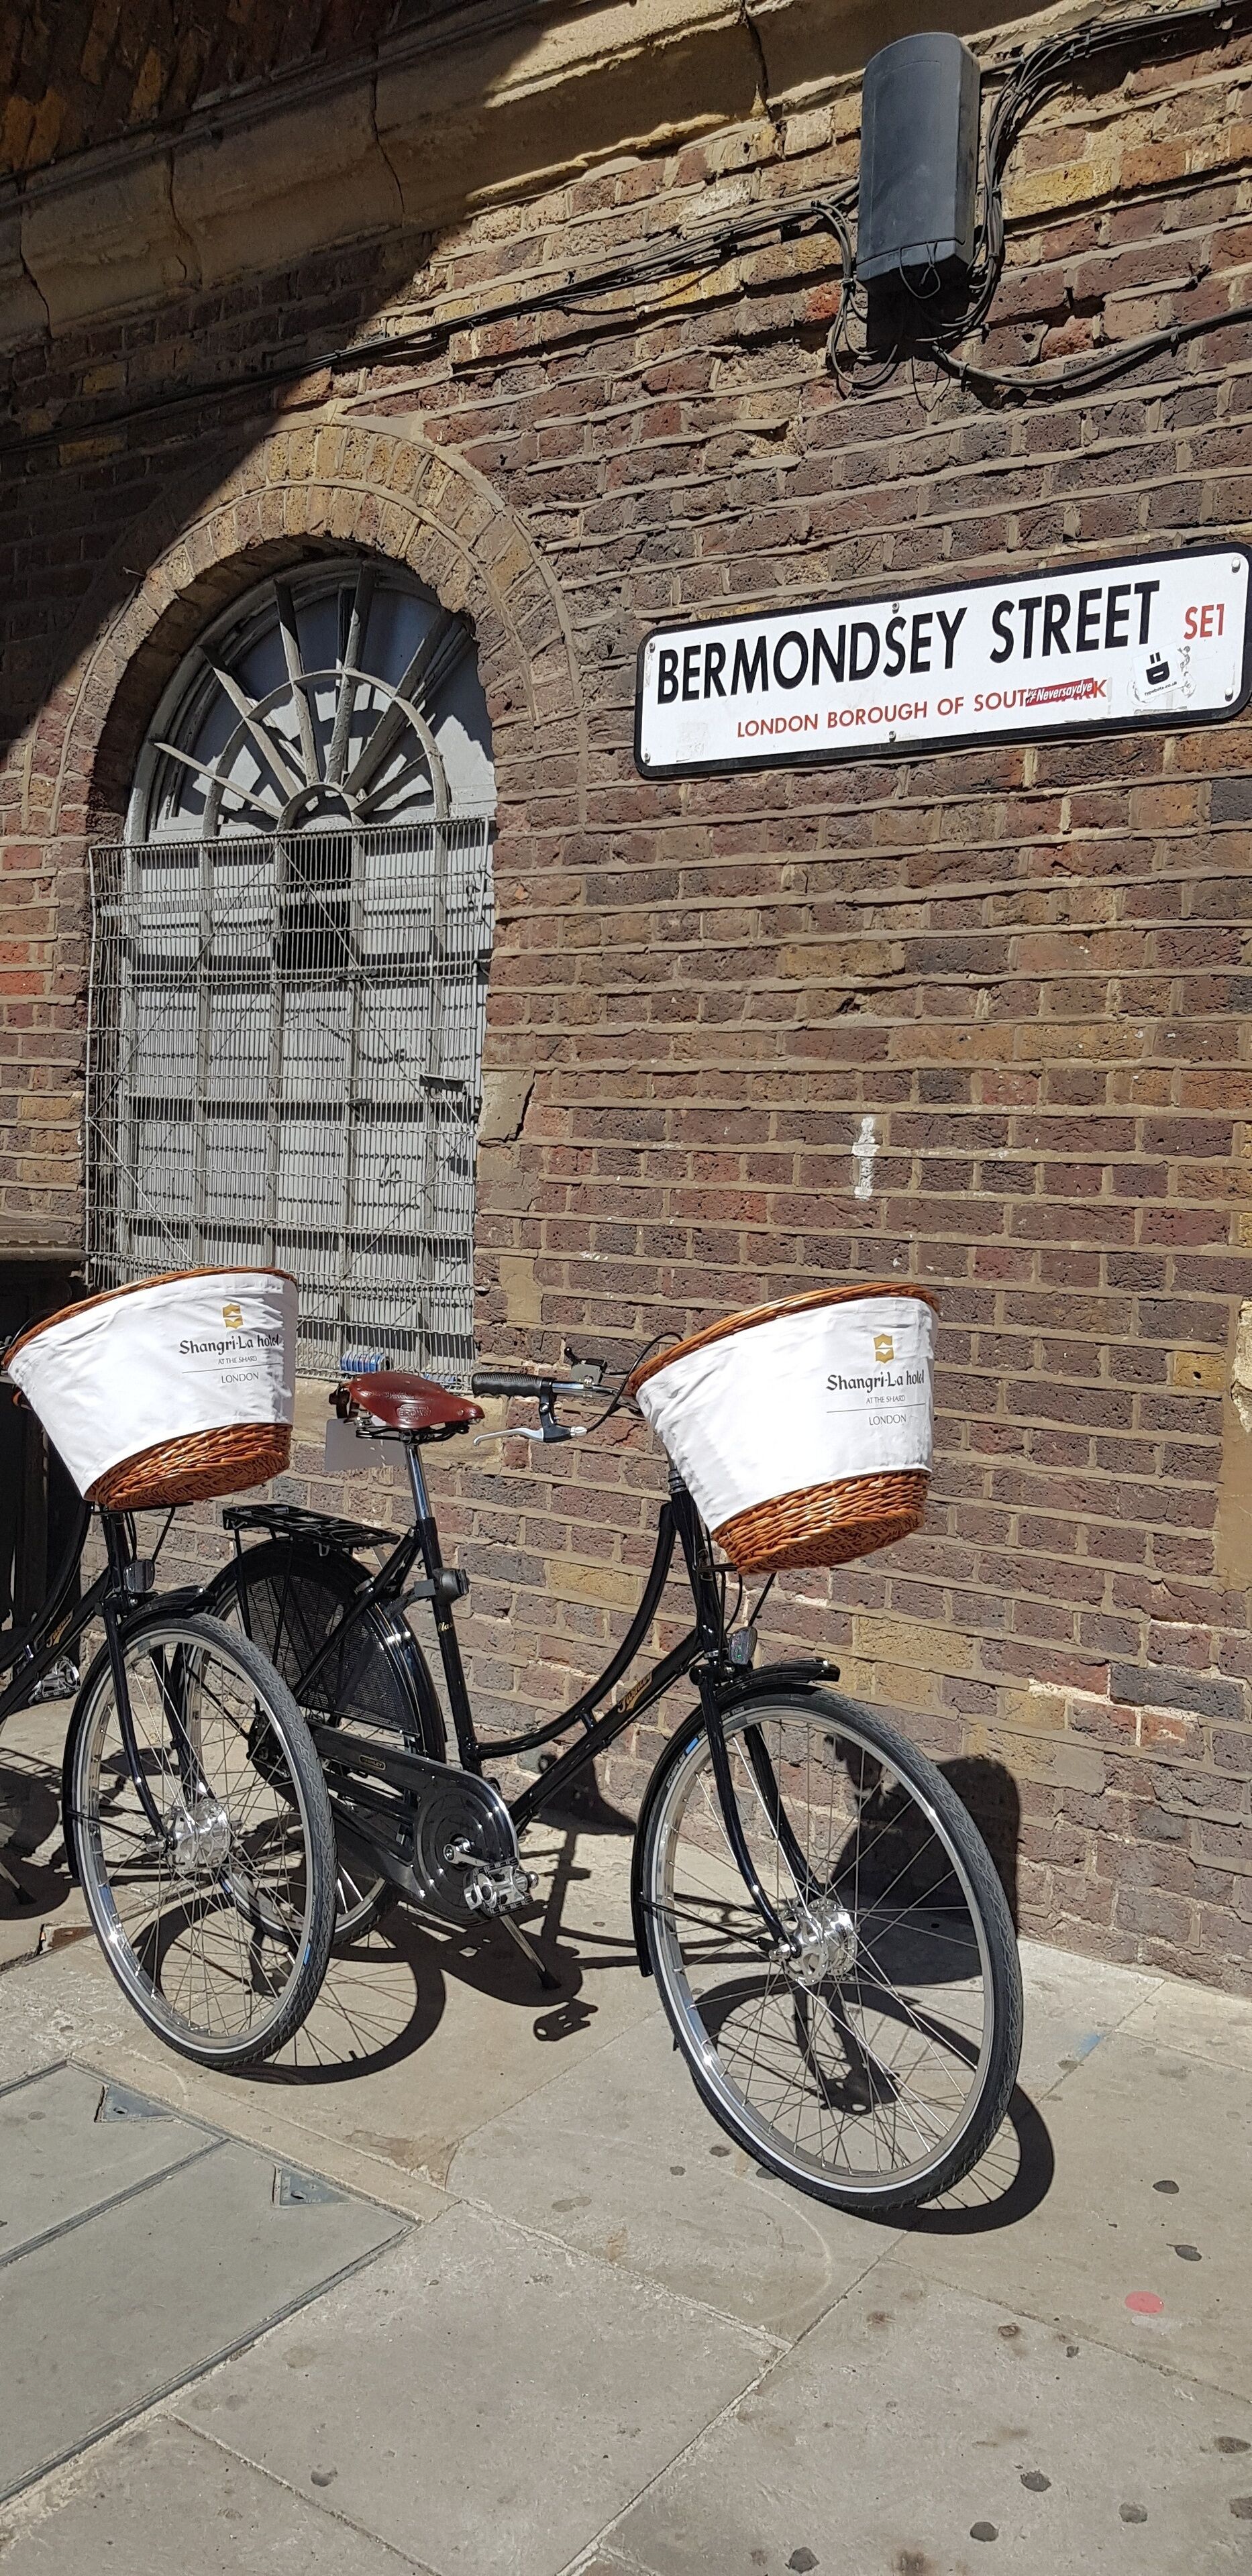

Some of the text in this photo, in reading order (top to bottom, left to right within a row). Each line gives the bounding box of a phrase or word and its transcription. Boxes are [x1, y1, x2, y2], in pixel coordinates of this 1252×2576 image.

[1184, 604, 1225, 640] SE1
[658, 580, 1161, 704] BERMONDSEY STREET
[737, 679, 1107, 738] LONDON BOROUGH OF SOUTK
[179, 1334, 279, 1355] Shangri-La hotel
[221, 1372, 259, 1383] LONDON
[826, 1369, 924, 1393] Shangri-La hotel
[869, 1414, 906, 1426] LONDON
